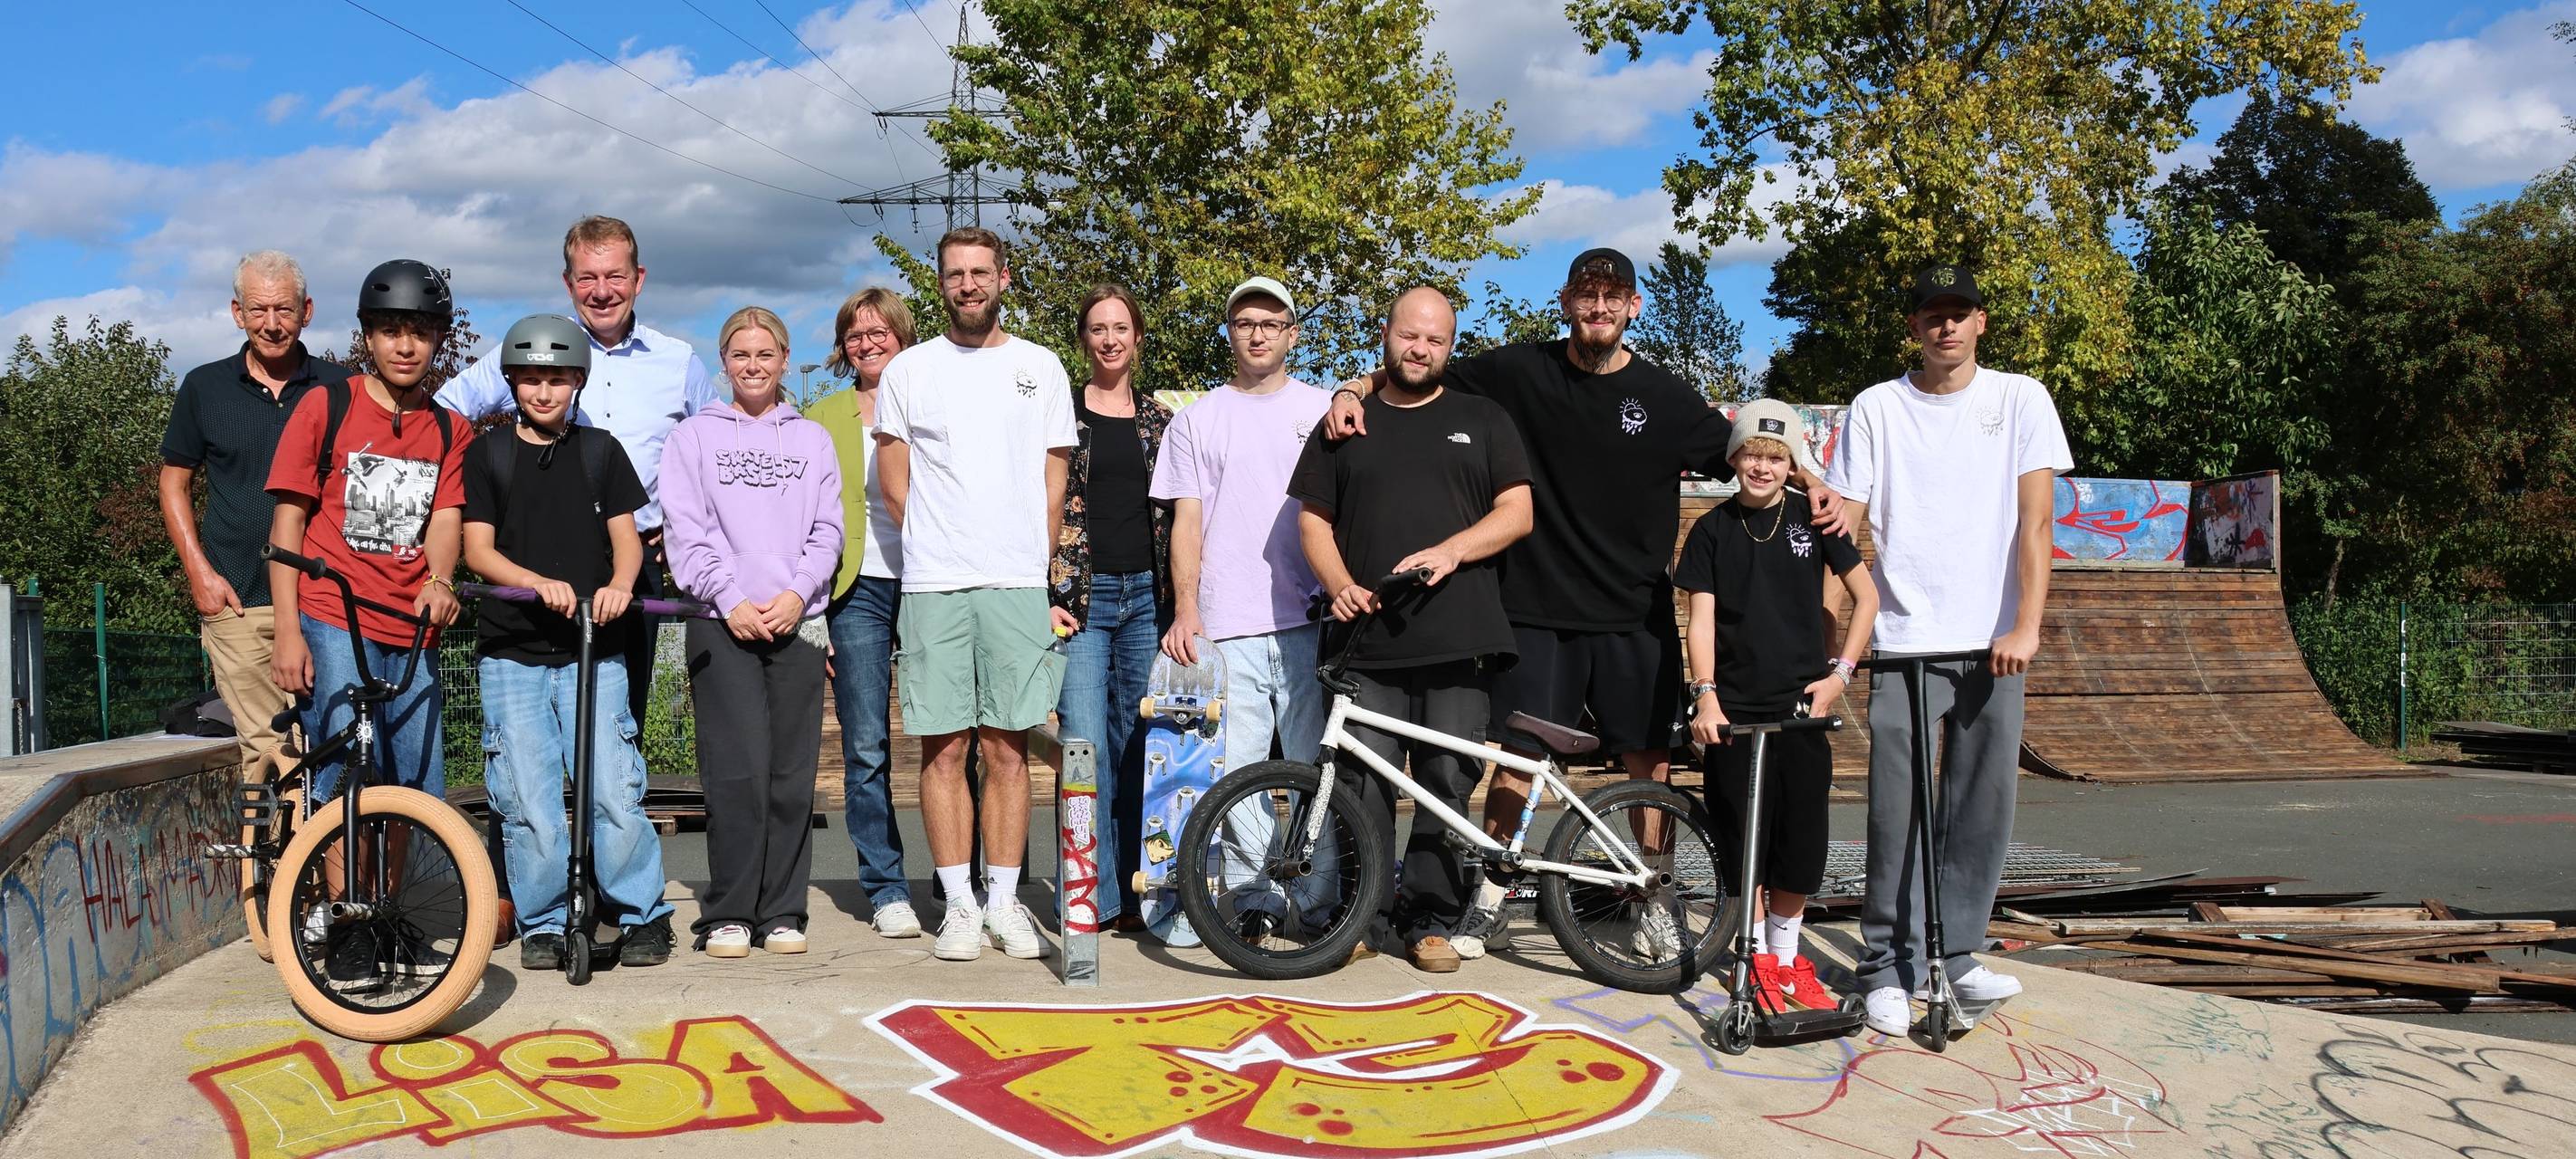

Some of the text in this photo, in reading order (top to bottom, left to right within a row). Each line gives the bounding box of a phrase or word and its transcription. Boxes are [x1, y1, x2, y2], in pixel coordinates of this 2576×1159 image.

[715, 448, 808, 480] SKATE 57
[719, 463, 778, 487] BASE
[76, 834, 157, 943] HALA
